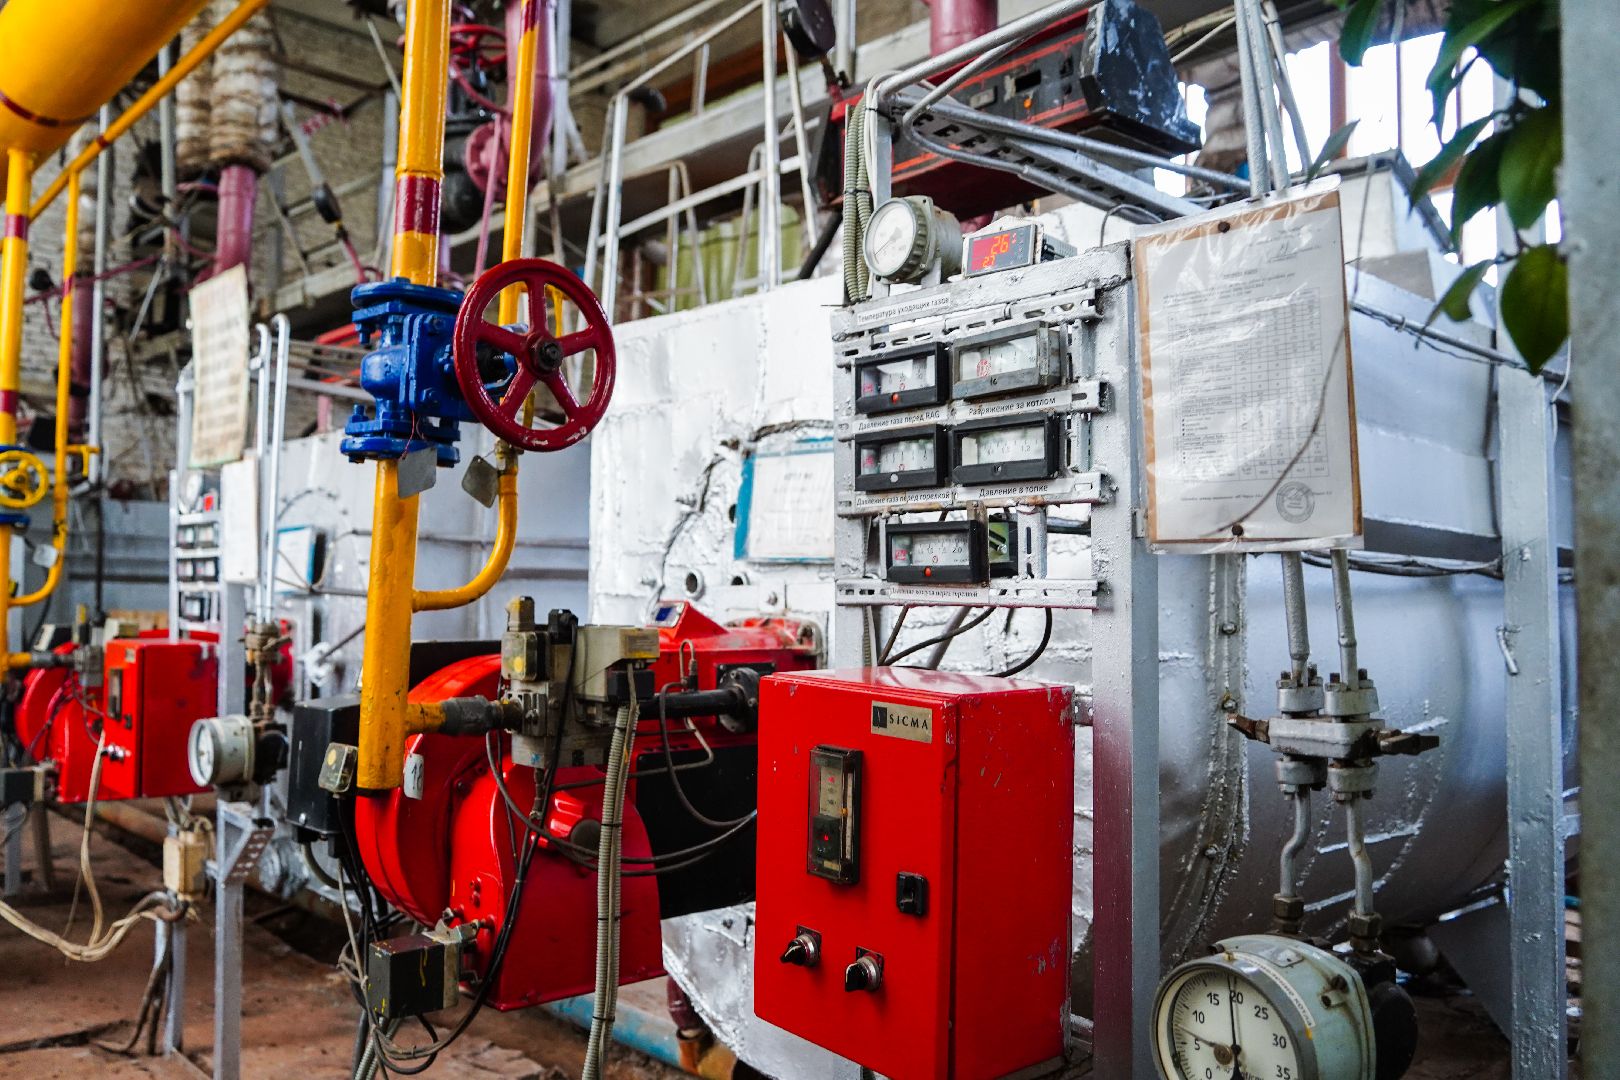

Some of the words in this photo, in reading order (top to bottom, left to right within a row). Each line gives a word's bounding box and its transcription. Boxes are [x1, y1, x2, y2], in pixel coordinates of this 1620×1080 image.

[991, 234, 1009, 255] 26
[982, 255, 995, 268] 27
[858, 309, 896, 321] Температура
[1016, 402, 1025, 410] за
[1026, 397, 1056, 408] котлом
[859, 420, 888, 431] Давление
[904, 414, 924, 423] перед
[856, 497, 885, 506] Давление
[919, 491, 950, 501] горелкой
[979, 487, 1017, 498] Давление
[1018, 486, 1024, 494] в
[1025, 485, 1048, 494] топке
[1206, 992, 1220, 1006] 15
[1229, 990, 1244, 1005] 20
[1192, 1009, 1205, 1024] 10
[1254, 1005, 1269, 1020] 25
[1194, 1039, 1201, 1051] 5
[1272, 1033, 1287, 1049] 30
[1205, 1067, 1213, 1080] 0
[1276, 1064, 1291, 1080] 35
